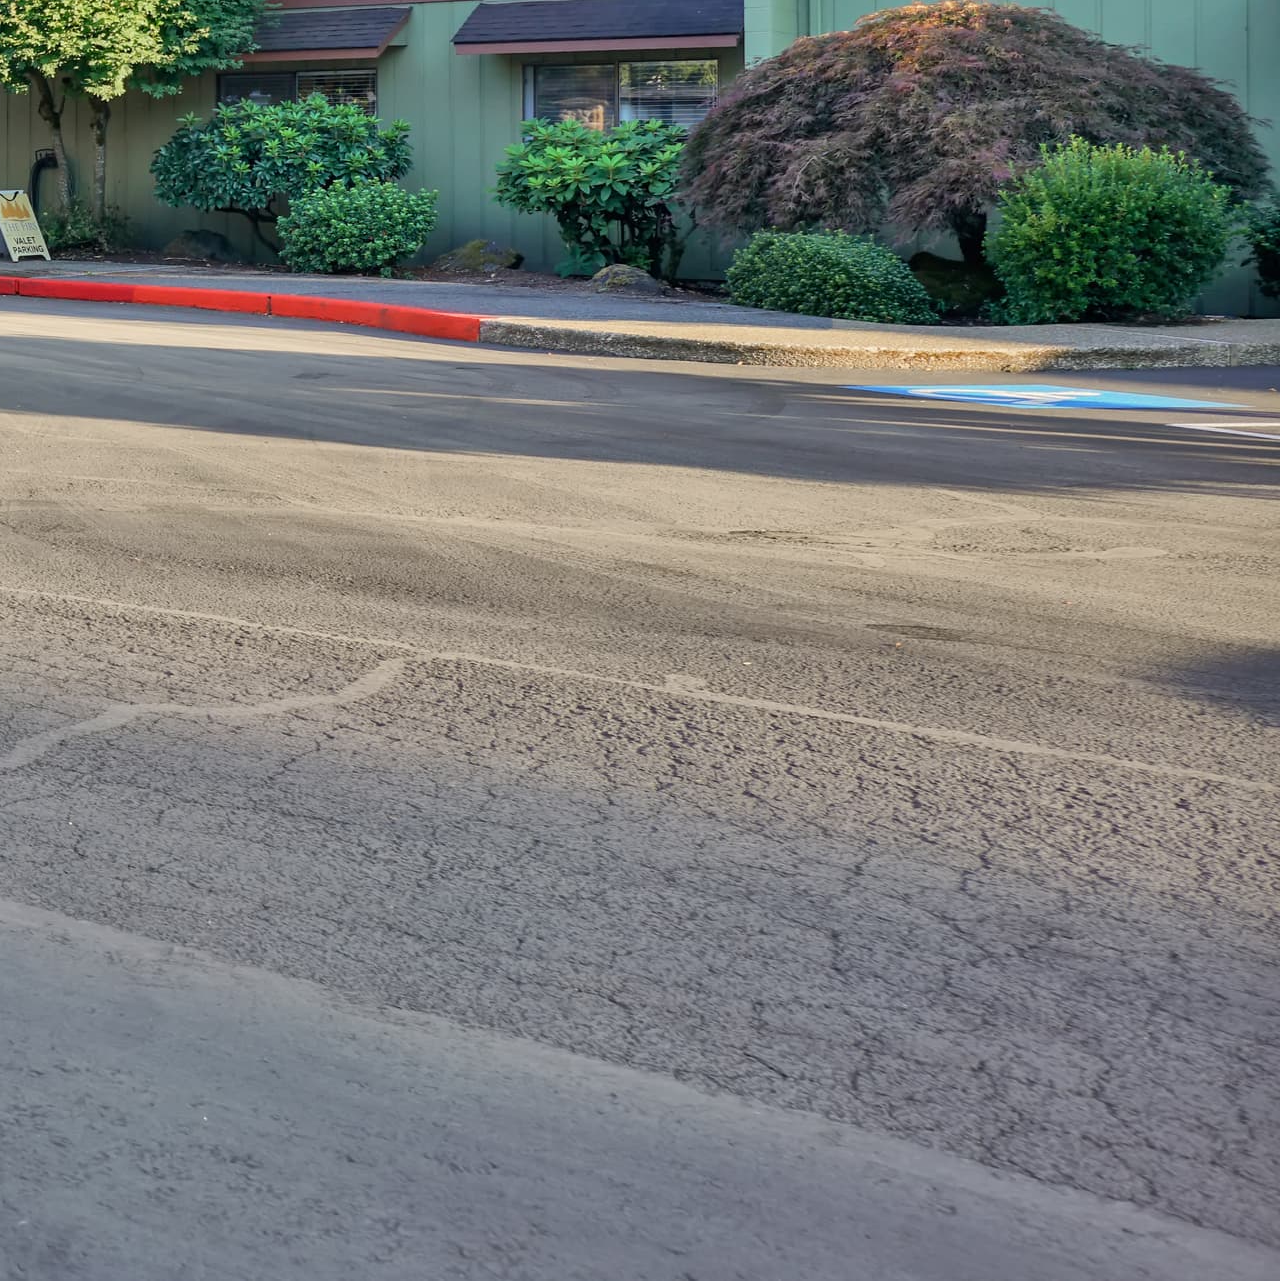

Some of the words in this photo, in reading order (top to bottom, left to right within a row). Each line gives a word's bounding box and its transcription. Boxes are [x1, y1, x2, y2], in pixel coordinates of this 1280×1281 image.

[4, 222, 20, 232] THE
[13, 236, 36, 245] VALET
[13, 245, 44, 254] PARKING
